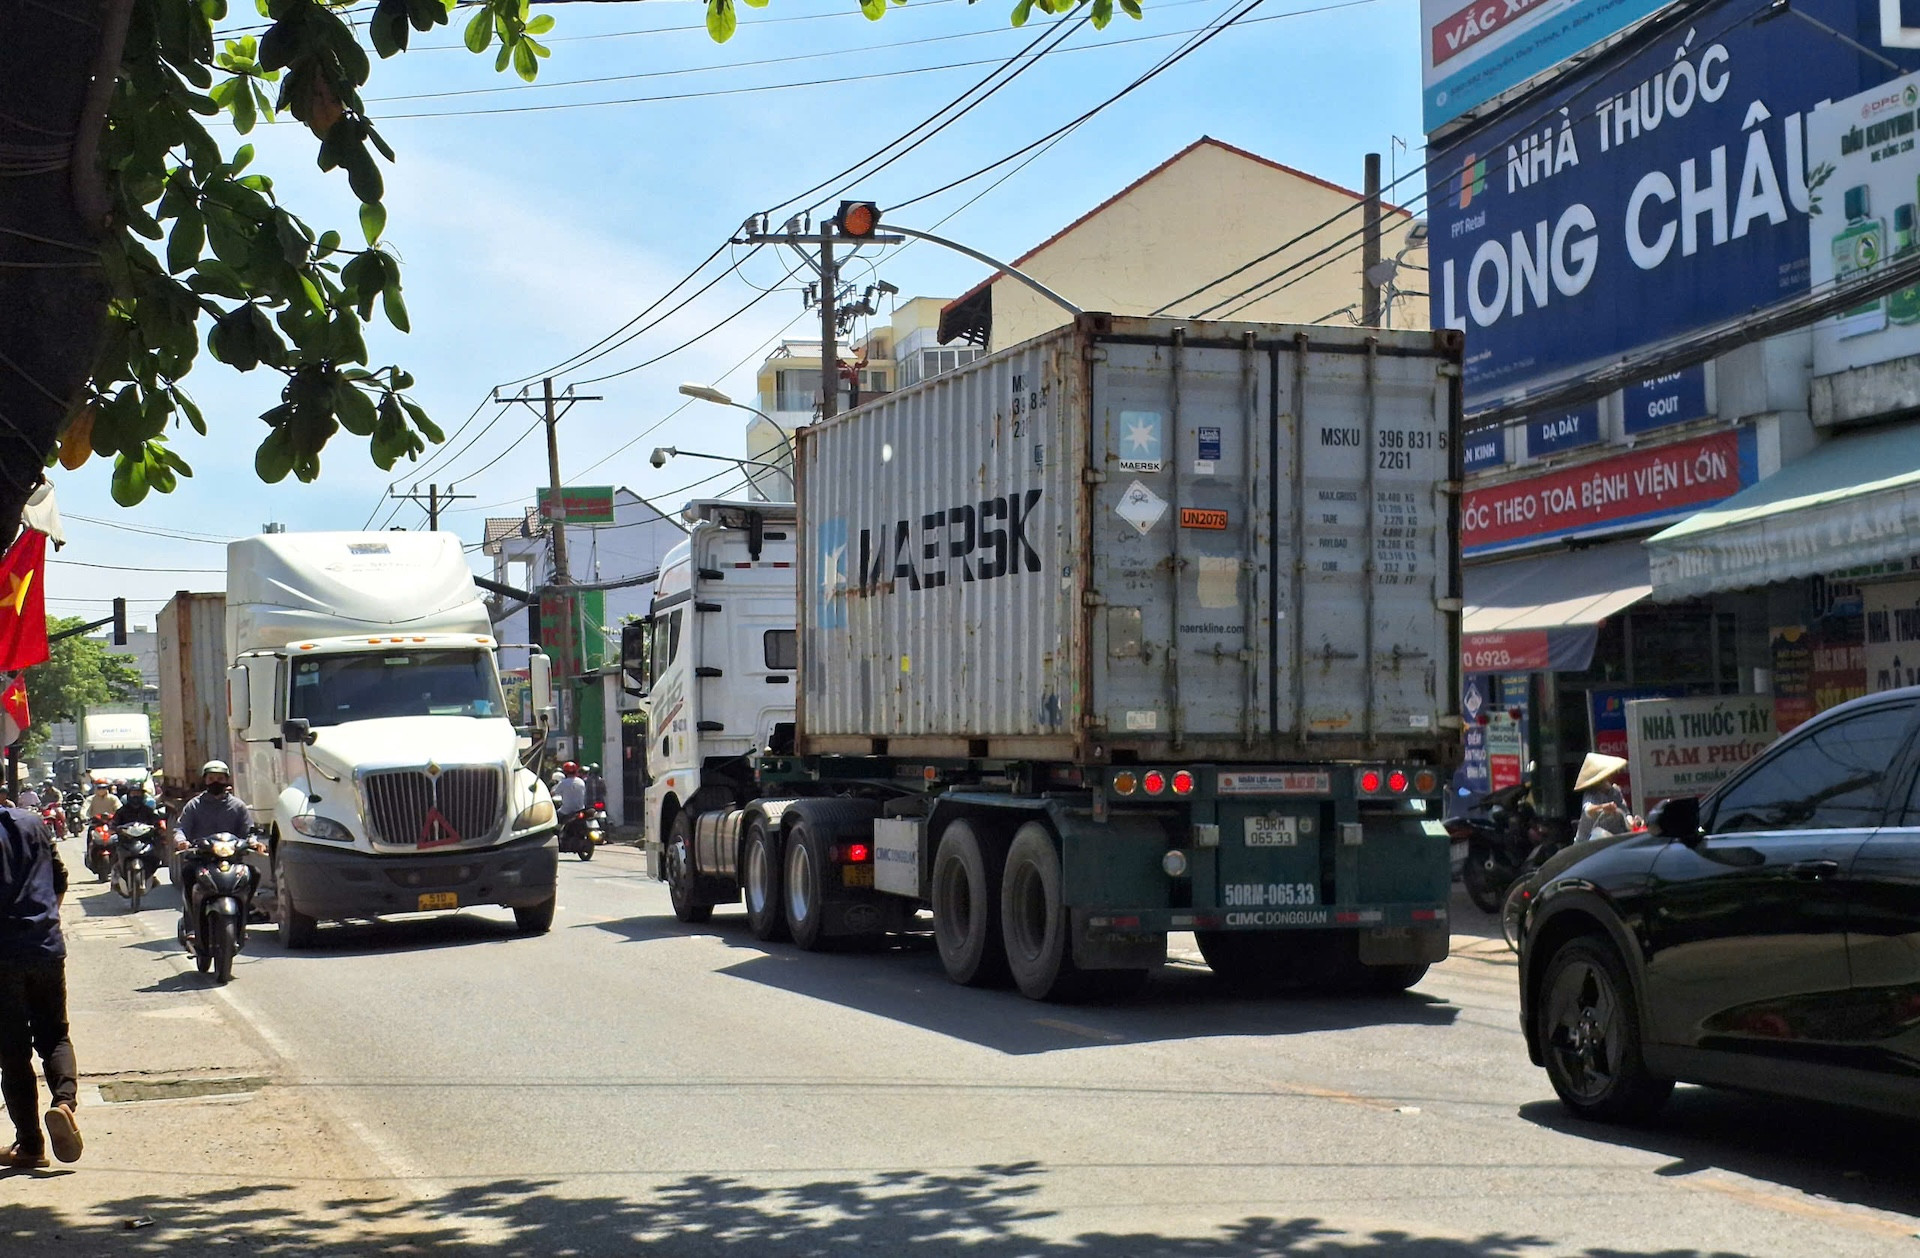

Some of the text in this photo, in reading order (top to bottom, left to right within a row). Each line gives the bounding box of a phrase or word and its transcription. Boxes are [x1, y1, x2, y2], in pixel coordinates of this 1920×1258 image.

[1507, 27, 1730, 194] NHÀ THUỐC
[1451, 209, 1486, 239] FPT Retail
[1443, 203, 1598, 335] LONG
[1648, 395, 1679, 418] GOUT
[1321, 427, 1360, 447] MSKU
[1379, 430, 1403, 449] 396
[1408, 431, 1432, 449] 831
[1542, 415, 1579, 442] DẠ DÀY
[1378, 451, 1411, 469] 22G1
[1474, 442, 1496, 461] KINH
[1120, 461, 1160, 471] MAERSK
[1494, 498, 1536, 525] THEO
[1541, 486, 1577, 515] TOA
[1582, 471, 1628, 513] BỆNH
[1634, 458, 1678, 500] VIỆN
[1684, 447, 1727, 486] LỚN
[1182, 511, 1226, 526] UN2078
[1322, 514, 1338, 524] TARE
[859, 488, 1043, 600] MAERSK
[1319, 538, 1348, 548] PAYLOAD
[1321, 561, 1338, 572] CUBE
[1476, 650, 1511, 666] 6928
[1642, 702, 1770, 741] NHÀ THUỐC TÂY
[1650, 744, 1699, 767] TÂM
[1250, 831, 1292, 844] 065.33
[1225, 883, 1315, 906] 50RM-065.33
[1226, 910, 1328, 925] CIMC DONGGUAN
